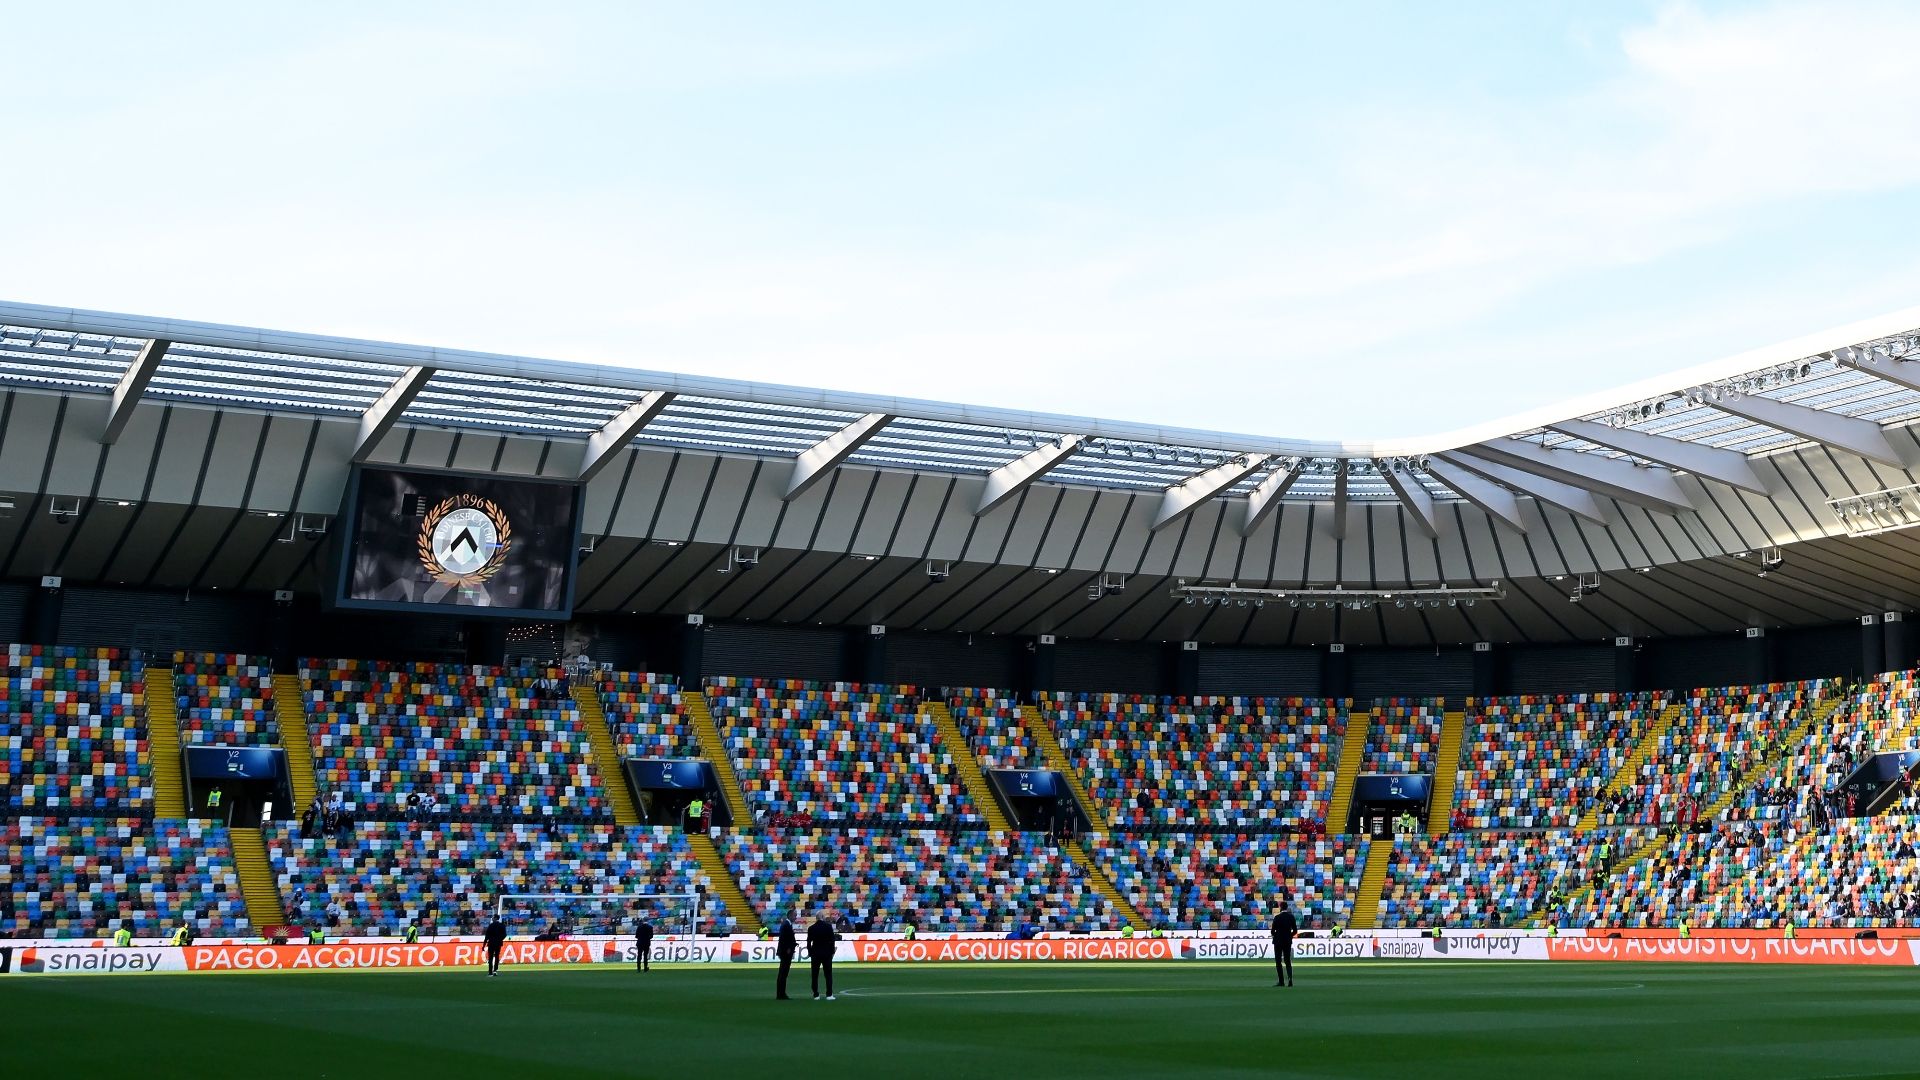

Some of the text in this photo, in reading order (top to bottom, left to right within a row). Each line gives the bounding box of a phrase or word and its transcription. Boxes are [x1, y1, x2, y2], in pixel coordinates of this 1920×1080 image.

[455, 493, 485, 509] 1896
[228, 750, 240, 758] V2
[662, 762, 673, 770] V3
[1020, 772, 1029, 780] V4
[625, 942, 718, 963] saipay
[1063, 940, 1166, 960] RICARICO
[1198, 939, 1268, 958] snaipay
[1296, 939, 1365, 958] snaipay
[1383, 938, 1424, 958] snaipay
[1451, 936, 1521, 955] snaipay
[1551, 938, 1899, 960] PAGO, ACQUISTO, RICARICO
[49, 948, 162, 973] snaipay
[292, 945, 445, 968] ACQUISTO,
